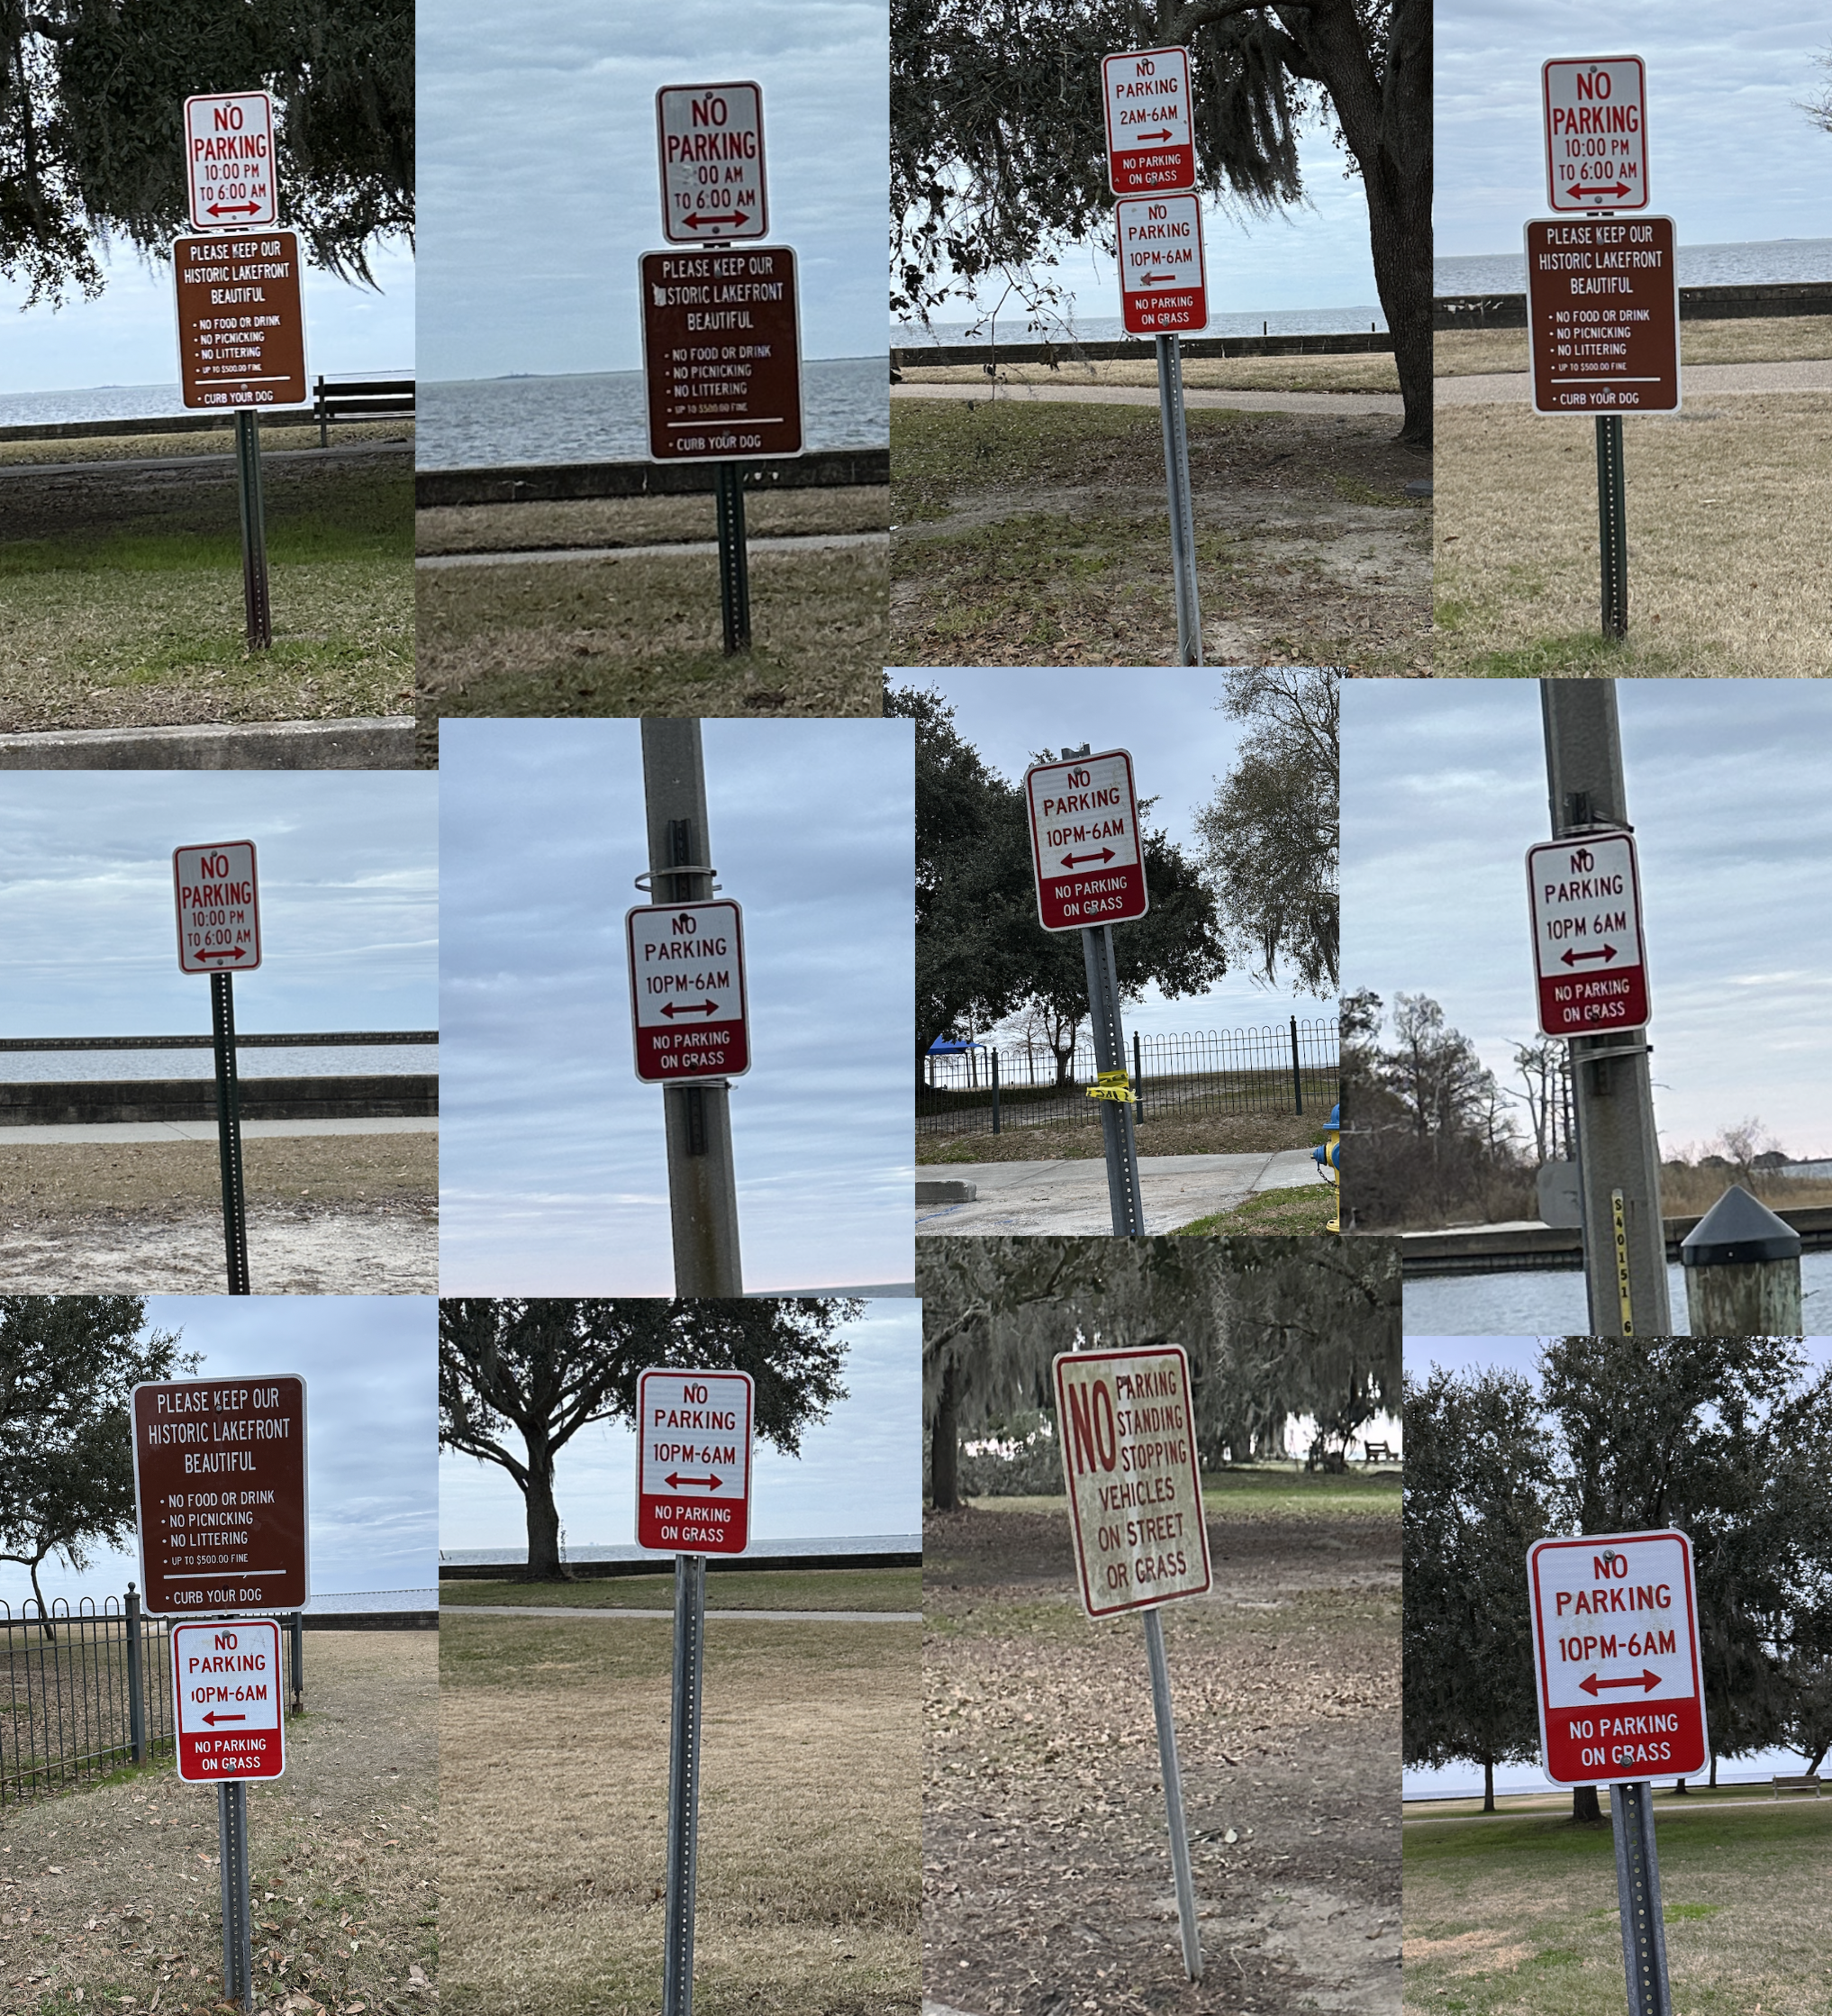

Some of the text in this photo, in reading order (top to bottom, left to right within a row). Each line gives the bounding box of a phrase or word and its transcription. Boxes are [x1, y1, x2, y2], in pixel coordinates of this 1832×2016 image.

[1136, 61, 1155, 77] NO
[1116, 77, 1177, 99] PARKING
[1577, 72, 1611, 100] NO
[214, 106, 243, 131] NO
[692, 98, 727, 127] NO
[1120, 104, 1177, 125] 2AM-6AM
[1553, 104, 1638, 135] PARKING
[195, 134, 267, 161] PARKING
[668, 131, 756, 163] PARKING
[1565, 138, 1628, 158] 10:00 PM
[1123, 154, 1181, 169] NO PARKING
[1559, 161, 1637, 180] TO 6:00 AM
[205, 164, 259, 180] 10:00 PM
[1129, 170, 1177, 185] ON GRASS
[200, 183, 266, 201] TO 6:00 AM
[675, 188, 755, 209] TO 6:00 AM
[1148, 205, 1166, 221] NO
[1129, 222, 1190, 241] PARKING
[1547, 225, 1653, 245] PLEASE KEEP OUR
[190, 241, 281, 261] PLEASE KEEP OUR
[1130, 249, 1193, 267] 10PM-6AM
[1539, 250, 1662, 270] HISTORIC LAKEFRONT
[184, 262, 289, 284] HISTORIC LAKEFRONT
[663, 257, 773, 278] PLEASE KEEP OUR
[211, 287, 266, 304] BEAUTIFUL
[1571, 277, 1633, 295] BEAUTIFUL
[1136, 295, 1193, 310] NO PARKING
[687, 311, 754, 331] BEAUTIFUL
[1141, 312, 1189, 325] ON GRASS
[1556, 309, 1650, 322] NO FOOD OR DRINK
[1556, 327, 1631, 340] NO PICNICKING
[1558, 343, 1627, 356] NO LITTERING
[1570, 363, 1579, 371] TO
[1581, 363, 1610, 371] $500.00
[1611, 362, 1627, 370] FINE
[204, 390, 273, 404] CURB YOUR DOG
[1560, 392, 1639, 405] CURB YOUR DOG
[676, 434, 761, 450] CURB YOUR DOG
[1067, 770, 1090, 790] NO
[1044, 787, 1120, 816] PARKING
[1047, 819, 1124, 847] 10PM-6AM
[201, 855, 229, 879] NO
[182, 881, 251, 909] PARKING
[1056, 876, 1127, 899] NO PARKING
[1545, 875, 1623, 904] PARKING
[1064, 896, 1123, 917] ON GRASS
[193, 910, 244, 927] 10:00 PM
[672, 917, 696, 935] NO
[1547, 911, 1626, 940] 10PM 6AM
[188, 929, 251, 946] TO 6:00 AM
[645, 938, 727, 961] PARKING
[647, 971, 730, 994] 10PM-6AM
[1555, 978, 1629, 1002] NO PARKING
[1564, 1002, 1625, 1022] ON GRASS
[653, 1031, 730, 1049] NO PARKING
[660, 1051, 724, 1068] ON GRASS
[684, 1385, 708, 1404] NO
[1117, 1371, 1176, 1400] PARKING
[158, 1387, 279, 1413] PLEASE KEEP OUR
[655, 1410, 735, 1430] PARKING
[1068, 1380, 1116, 1475] NO
[1118, 1405, 1183, 1437] STANDING
[149, 1418, 290, 1444] HISTORIC LAKEFRONT
[185, 1451, 256, 1474] BEAUTIFUL
[654, 1443, 735, 1465] 10PM-6AM
[1122, 1439, 1186, 1472] STOPPING
[168, 1490, 275, 1508] NO FOOD OR DRINK
[1099, 1476, 1174, 1512] VEHICLES
[169, 1512, 253, 1528] NO PICNICKING
[655, 1505, 731, 1522] NO PARKING
[170, 1531, 248, 1548] NO LITTERING
[661, 1526, 724, 1542] ON GRASS
[1098, 1513, 1183, 1551] ON STREET
[172, 1554, 249, 1566] UP TO $500.00 FINE
[1107, 1551, 1186, 1589] OR GRASS
[1594, 1555, 1628, 1580] NO
[174, 1588, 262, 1604] CURB YOUR DOG
[1556, 1584, 1671, 1616] PARKING
[215, 1633, 238, 1650] NO
[1559, 1630, 1676, 1661] 10PM-6AM
[189, 1655, 265, 1674] PARKING
[1570, 1713, 1679, 1739] NO PARKING
[195, 1739, 266, 1753] NO PARKING
[1582, 1742, 1671, 1766] ON GRASS
[202, 1757, 260, 1770] ON GRASS
